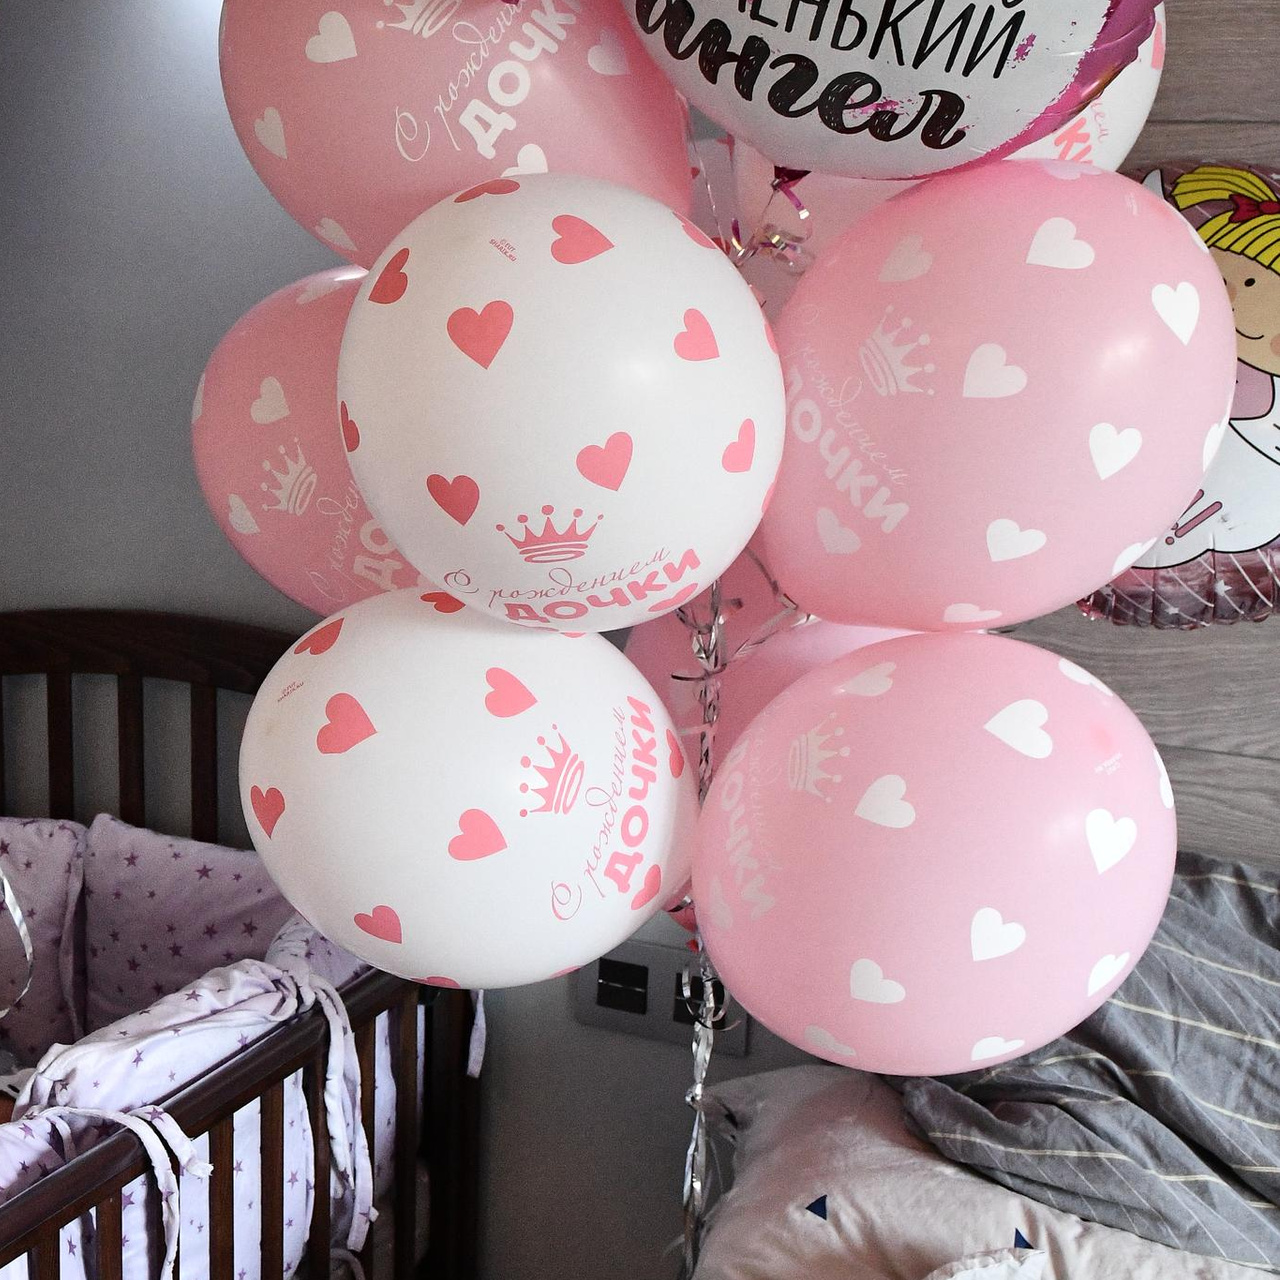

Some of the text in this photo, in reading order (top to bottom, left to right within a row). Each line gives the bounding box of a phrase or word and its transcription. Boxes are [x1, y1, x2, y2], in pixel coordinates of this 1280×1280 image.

[488, 547, 669, 608] рождением
[504, 547, 701, 624] ДОЧКИ
[584, 706, 626, 898] рождением
[604, 695, 657, 894] ДОЧКИ
